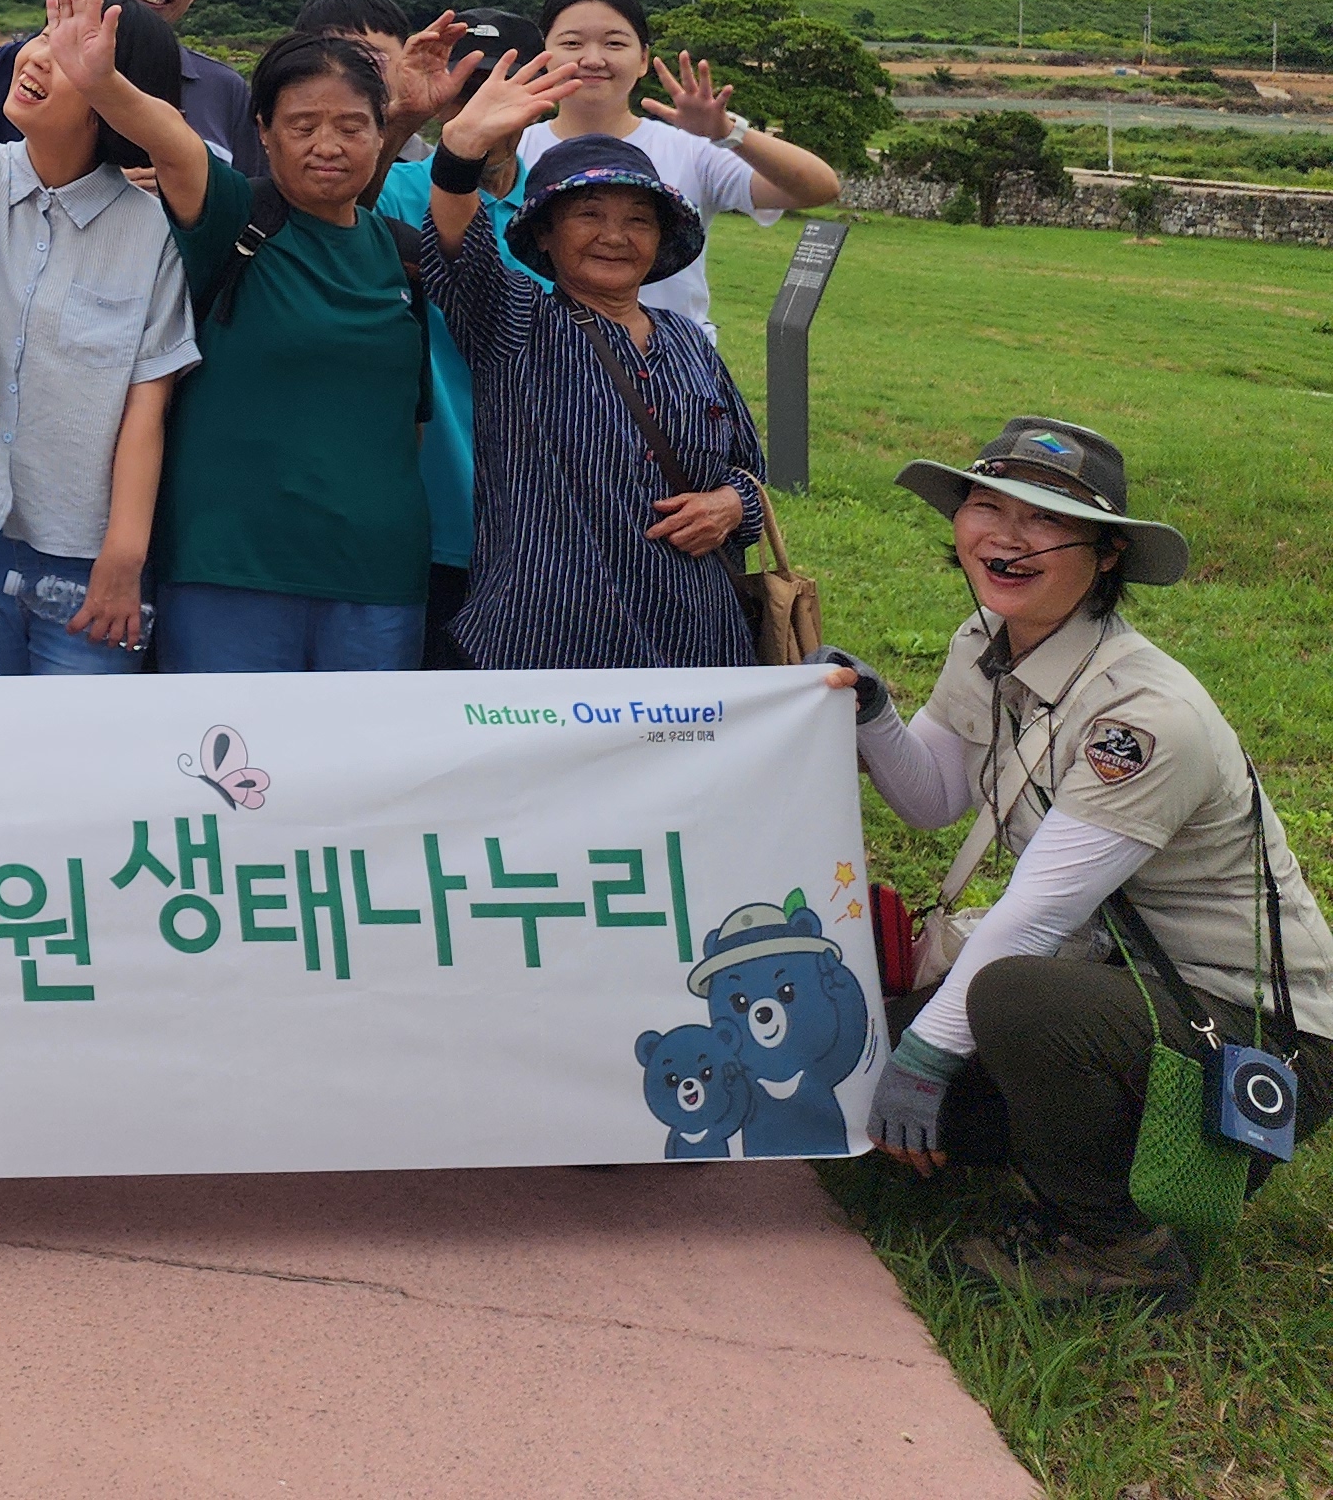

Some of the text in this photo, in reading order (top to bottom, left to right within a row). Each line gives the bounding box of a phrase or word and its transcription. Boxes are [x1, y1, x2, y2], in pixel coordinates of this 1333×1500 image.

[464, 701, 724, 727] Nature, Our Future!
[110, 813, 695, 980] 생태나누리
